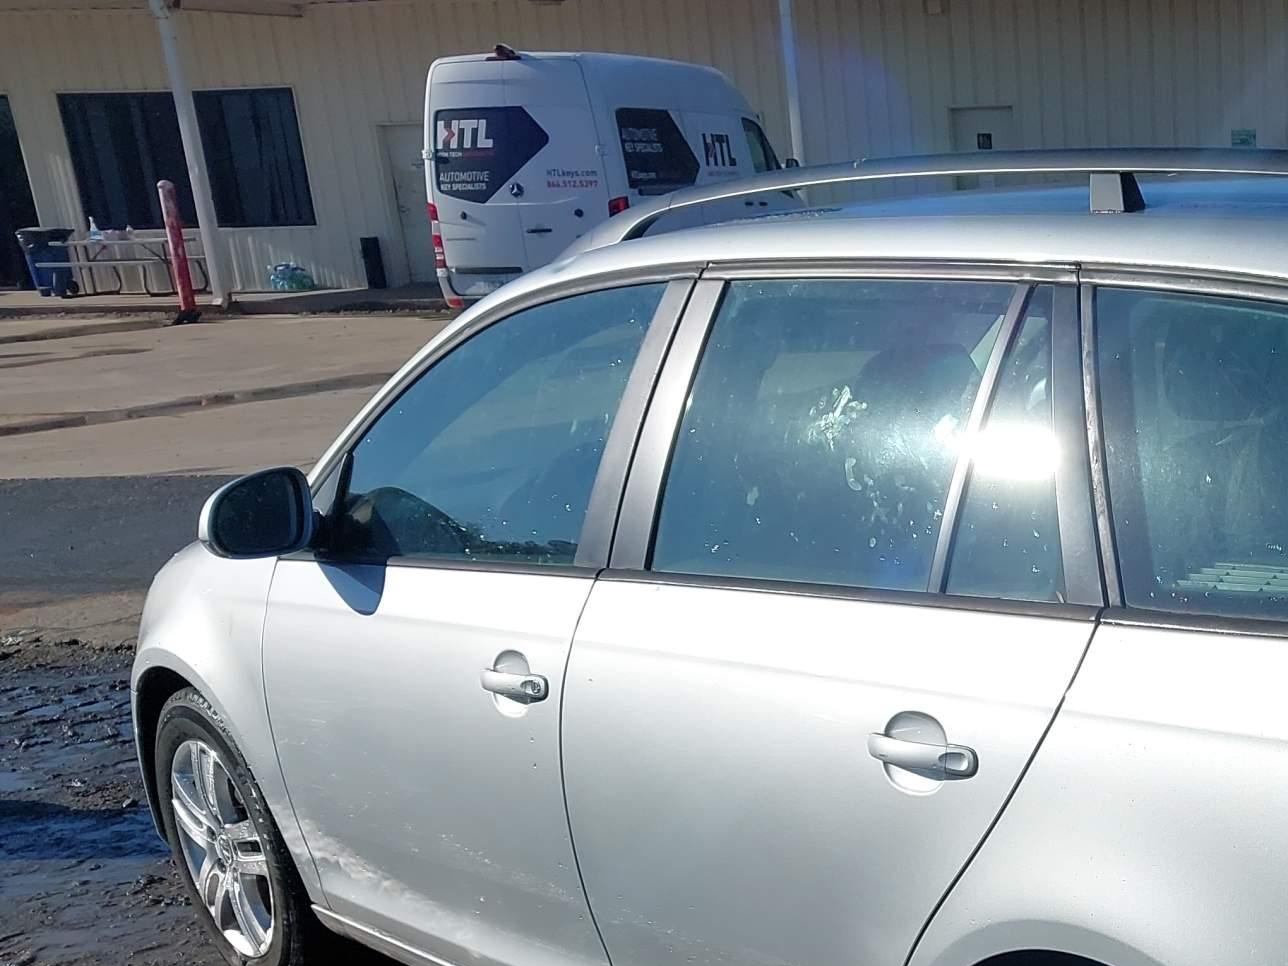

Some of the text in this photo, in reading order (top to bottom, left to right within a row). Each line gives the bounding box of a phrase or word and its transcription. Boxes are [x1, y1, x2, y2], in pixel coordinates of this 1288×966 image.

[436, 119, 493, 149] HTL
[702, 133, 737, 167] HTL
[439, 171, 490, 182] AUTOMOTIVE
[546, 168, 598, 179] HTLkeys.com
[440, 182, 487, 191] KEY SPECIALISTS
